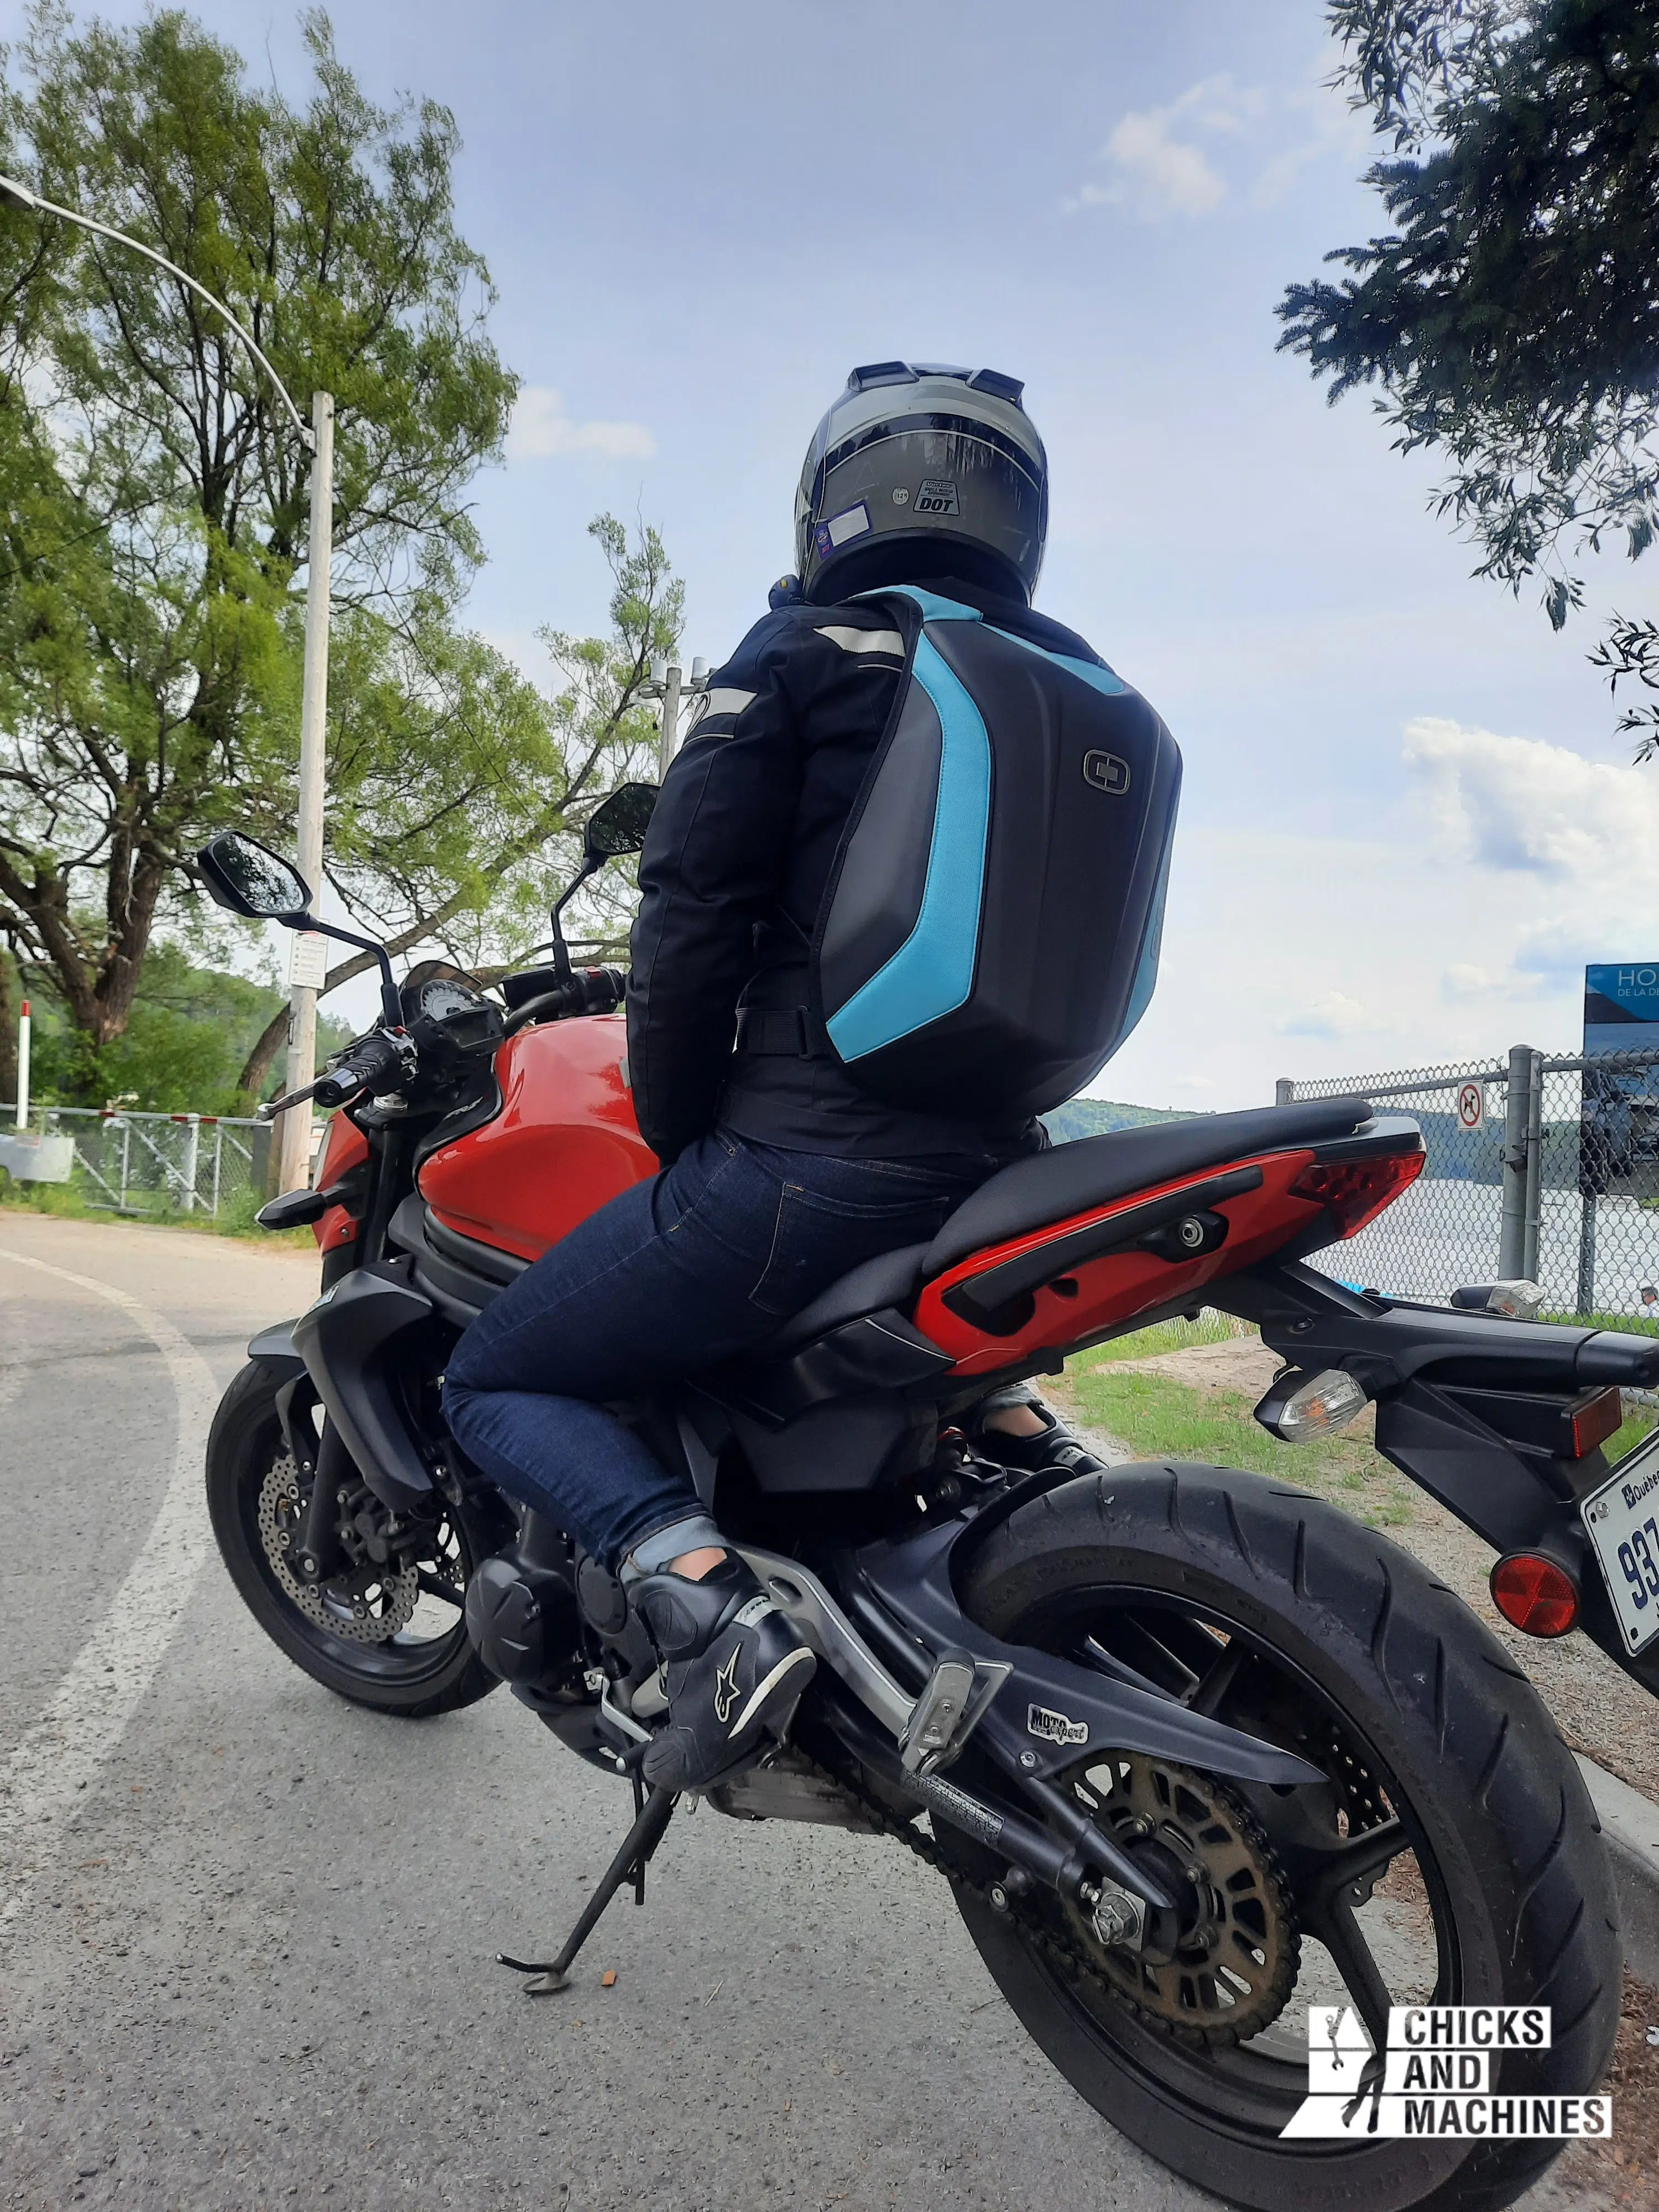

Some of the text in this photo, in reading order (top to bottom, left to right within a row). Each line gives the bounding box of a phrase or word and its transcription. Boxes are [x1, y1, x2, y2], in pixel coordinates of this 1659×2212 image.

[919, 498, 953, 512] DOT
[1618, 988, 1631, 997] DE
[1031, 1709, 1066, 1729] MOTO
